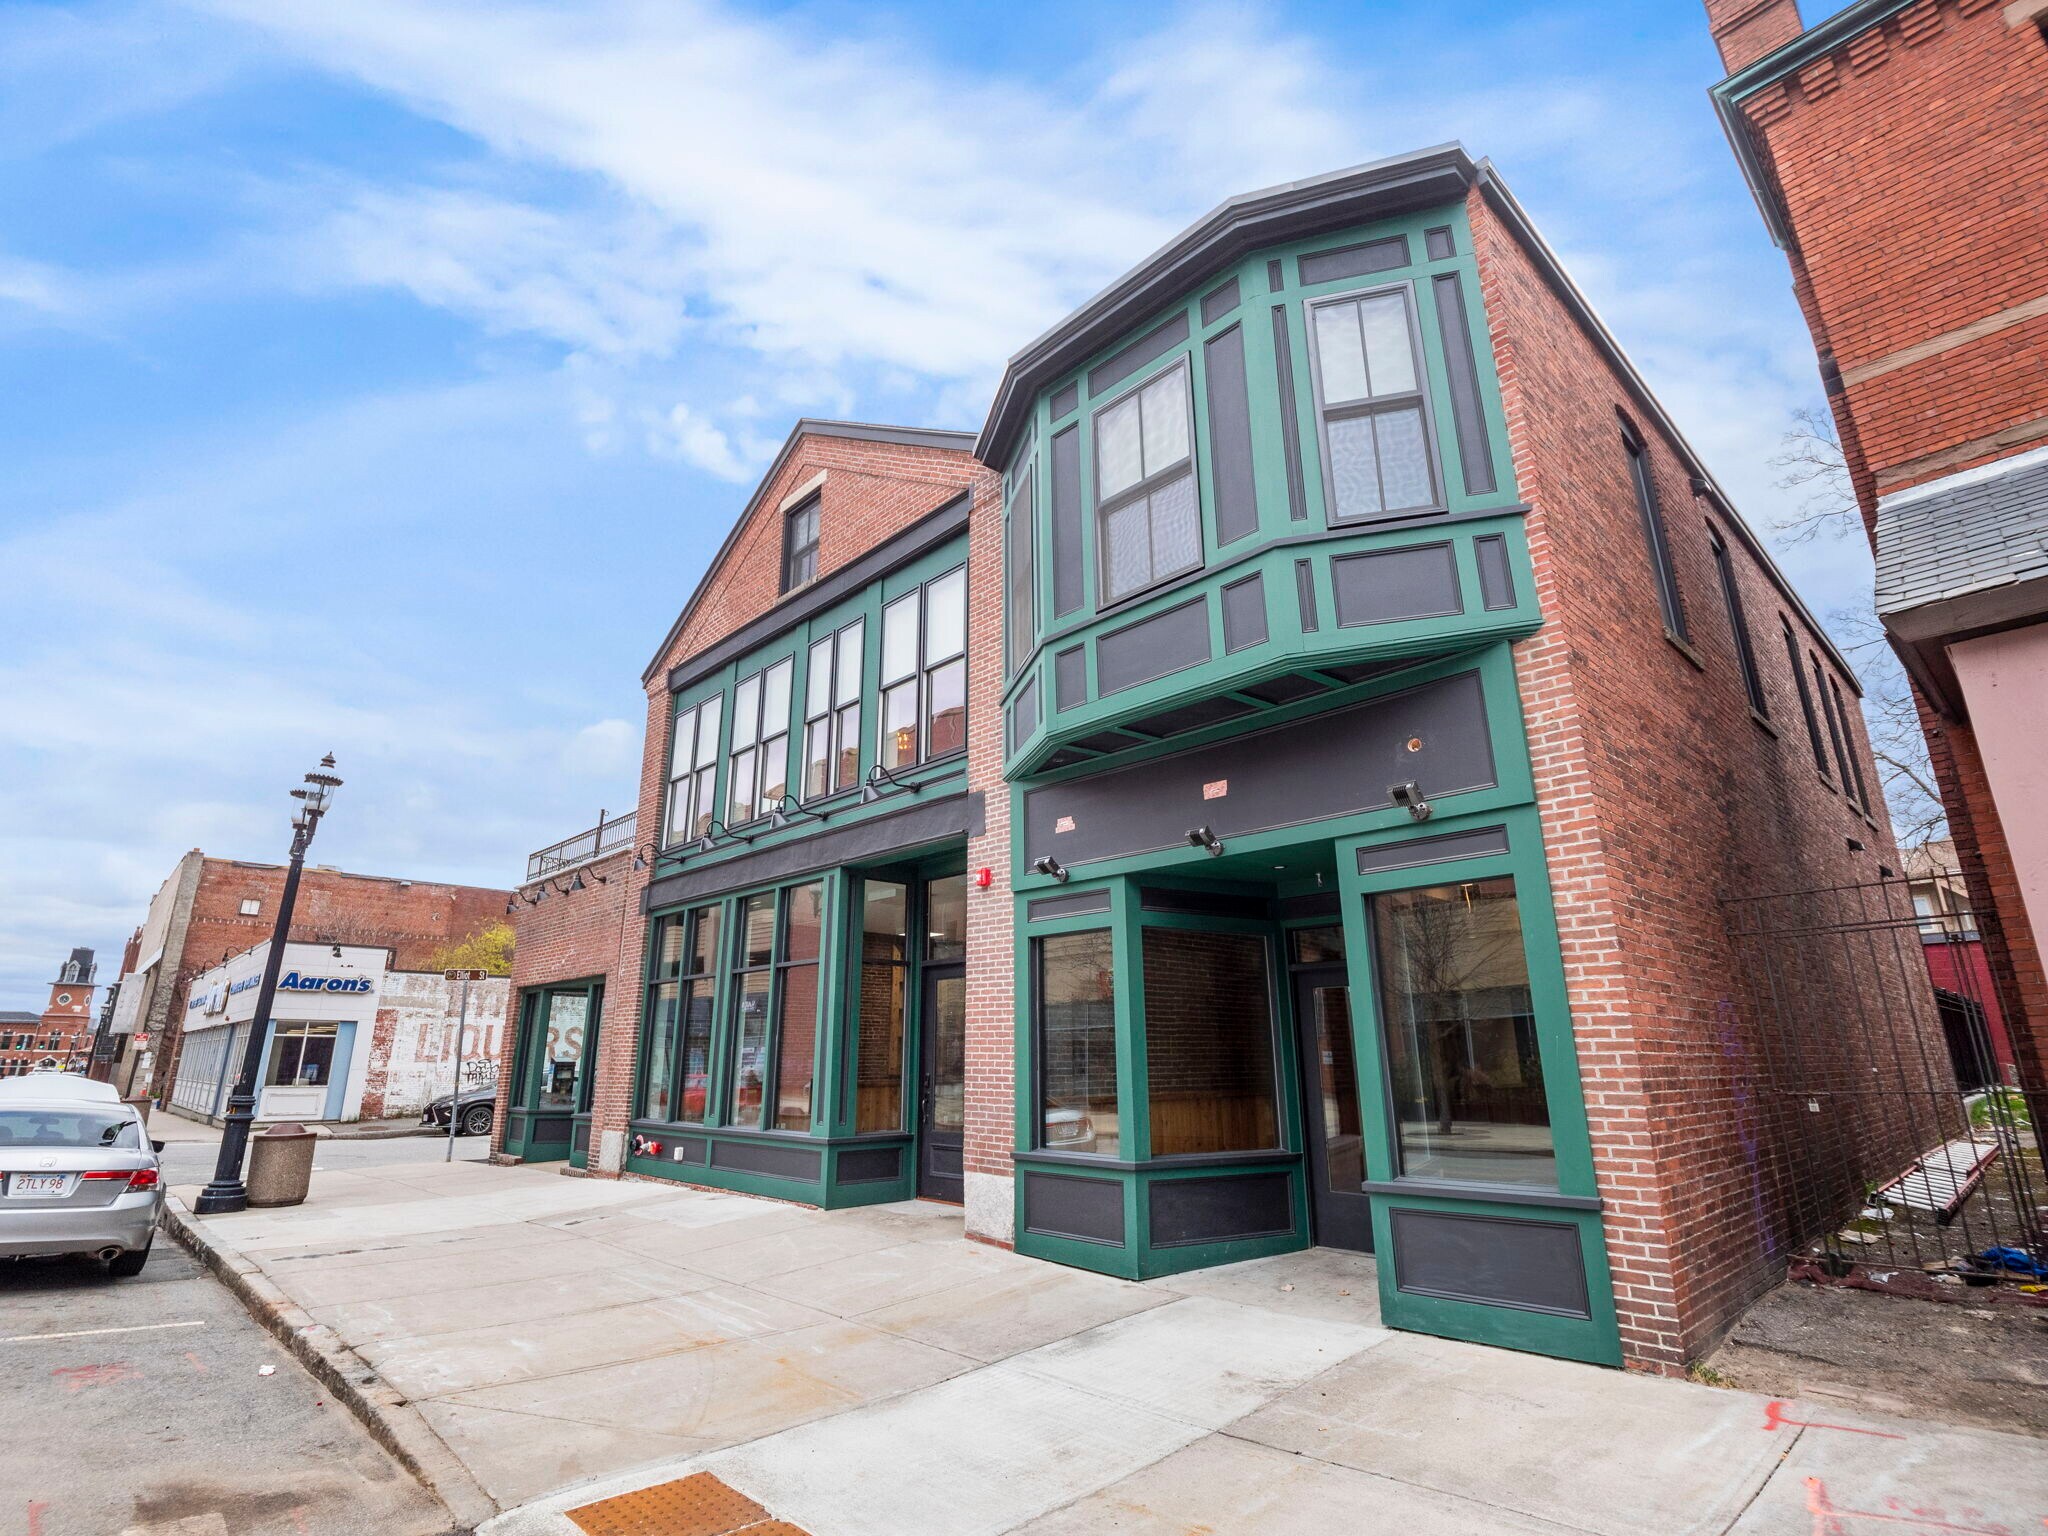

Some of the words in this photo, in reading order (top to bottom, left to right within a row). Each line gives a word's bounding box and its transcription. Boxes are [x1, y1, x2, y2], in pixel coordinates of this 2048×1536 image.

[278, 971, 372, 993] Aaron's
[16, 1178, 47, 1190] 2TLY
[49, 1178, 64, 1190] 98
